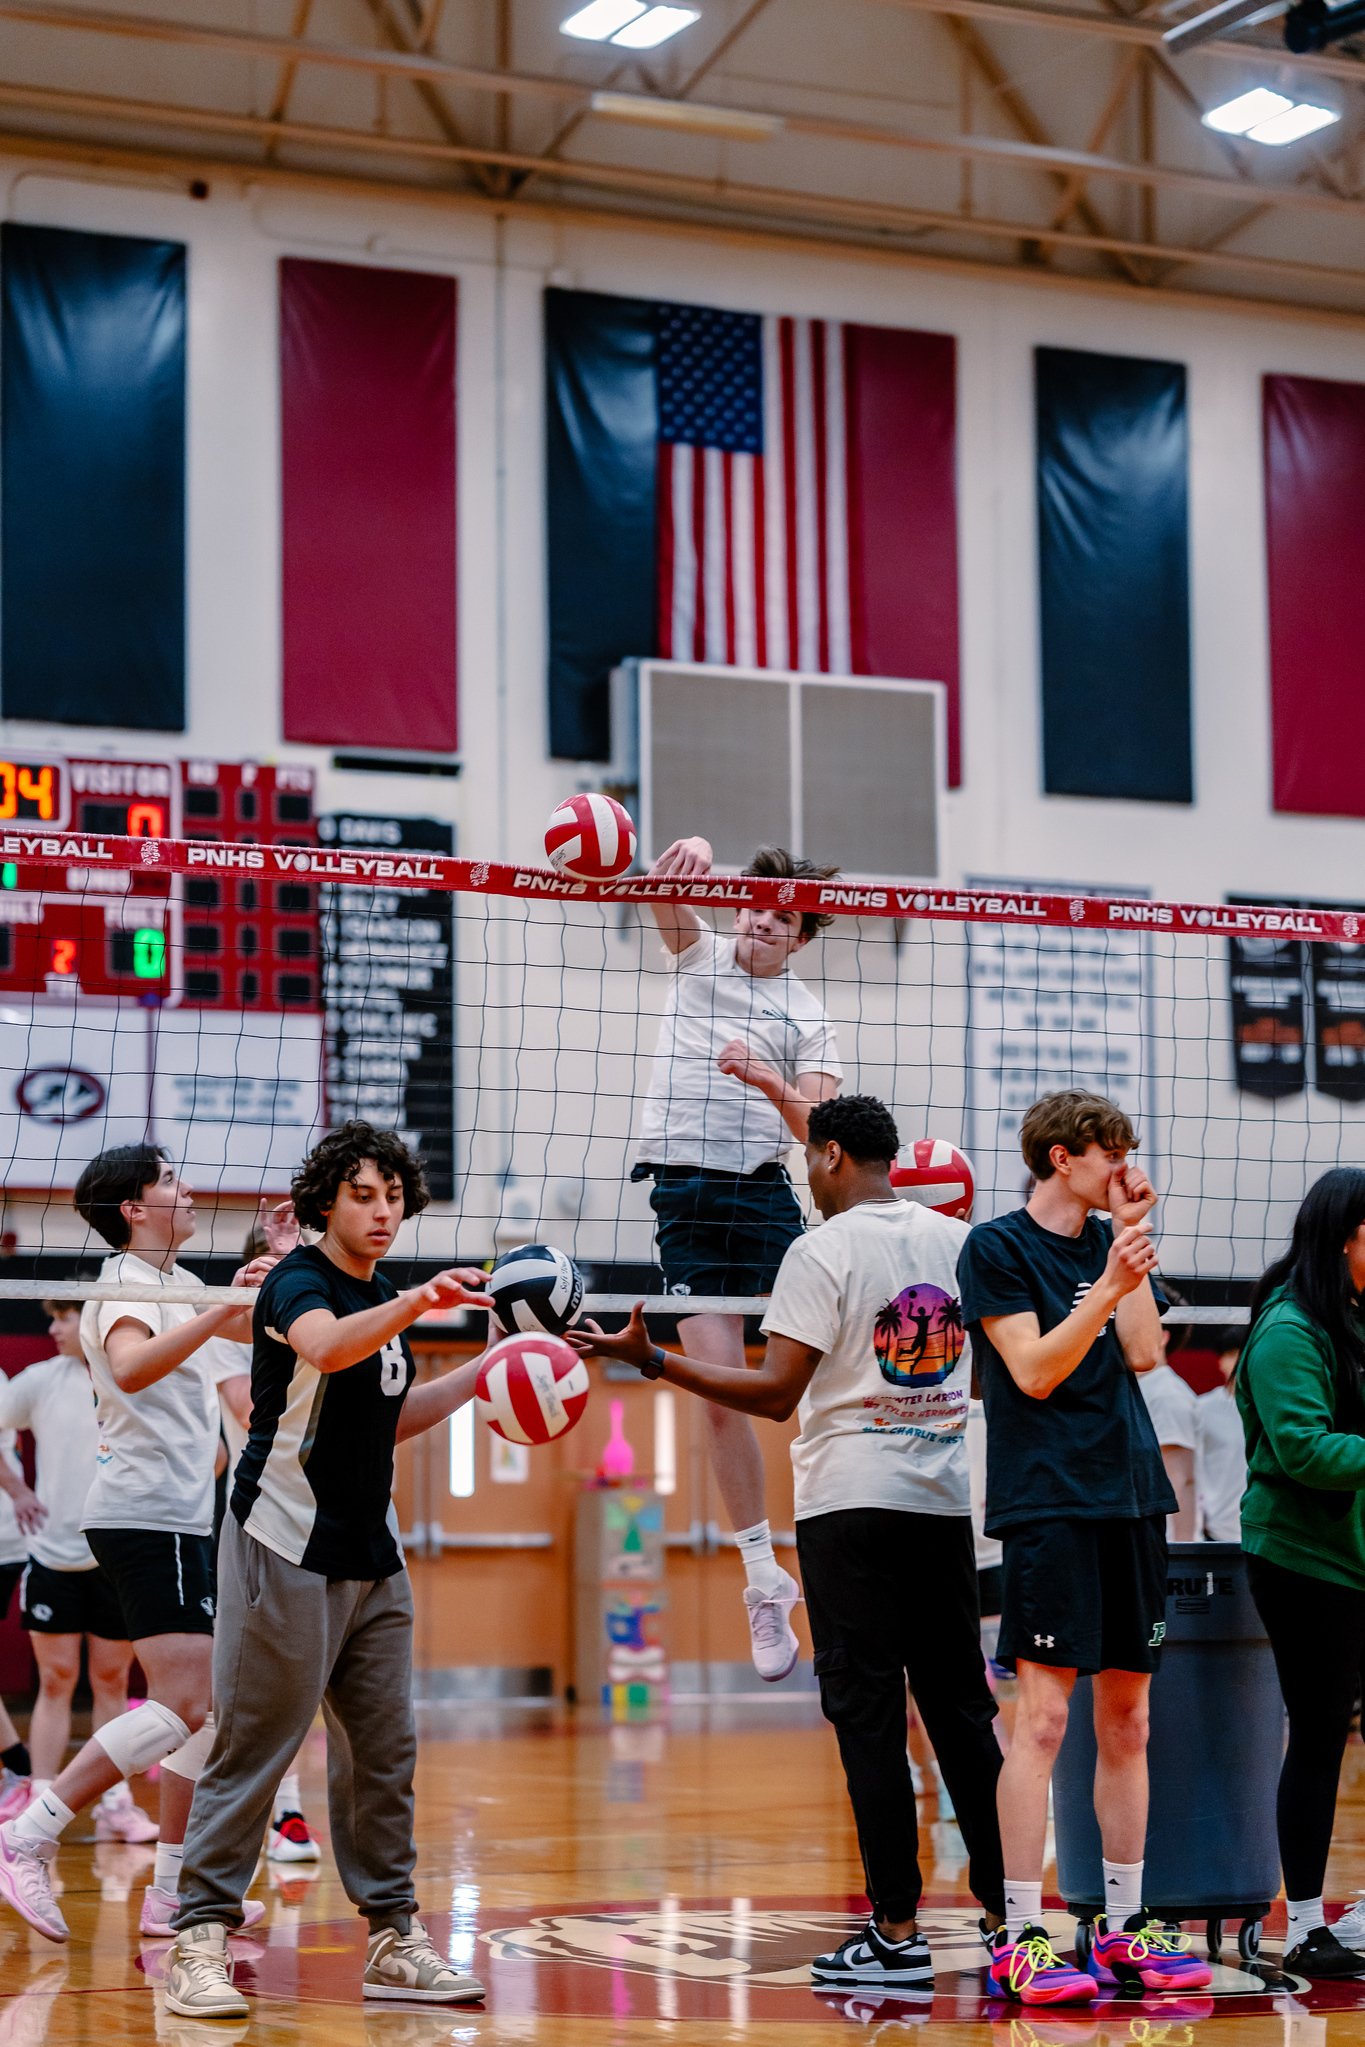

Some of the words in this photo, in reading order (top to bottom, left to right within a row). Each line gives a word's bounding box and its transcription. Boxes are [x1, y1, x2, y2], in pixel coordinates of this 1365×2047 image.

[70, 763, 170, 797] VISITOR
[0, 836, 113, 859] EYBALL
[187, 847, 265, 869] PNHS
[273, 851, 444, 880] VOLLEYBALL
[513, 873, 588, 895] PNHS
[598, 883, 753, 900] VOLLEYBALL
[819, 889, 888, 908] PNHS
[896, 892, 1046, 917] VOLLEYBALL
[1108, 904, 1173, 925] PNHS
[1180, 910, 1322, 933] VOLLEYBALL
[133, 927, 166, 979] 0
[925, 1389, 963, 1403] LARSON
[889, 1426, 938, 1442] CHARLIE
